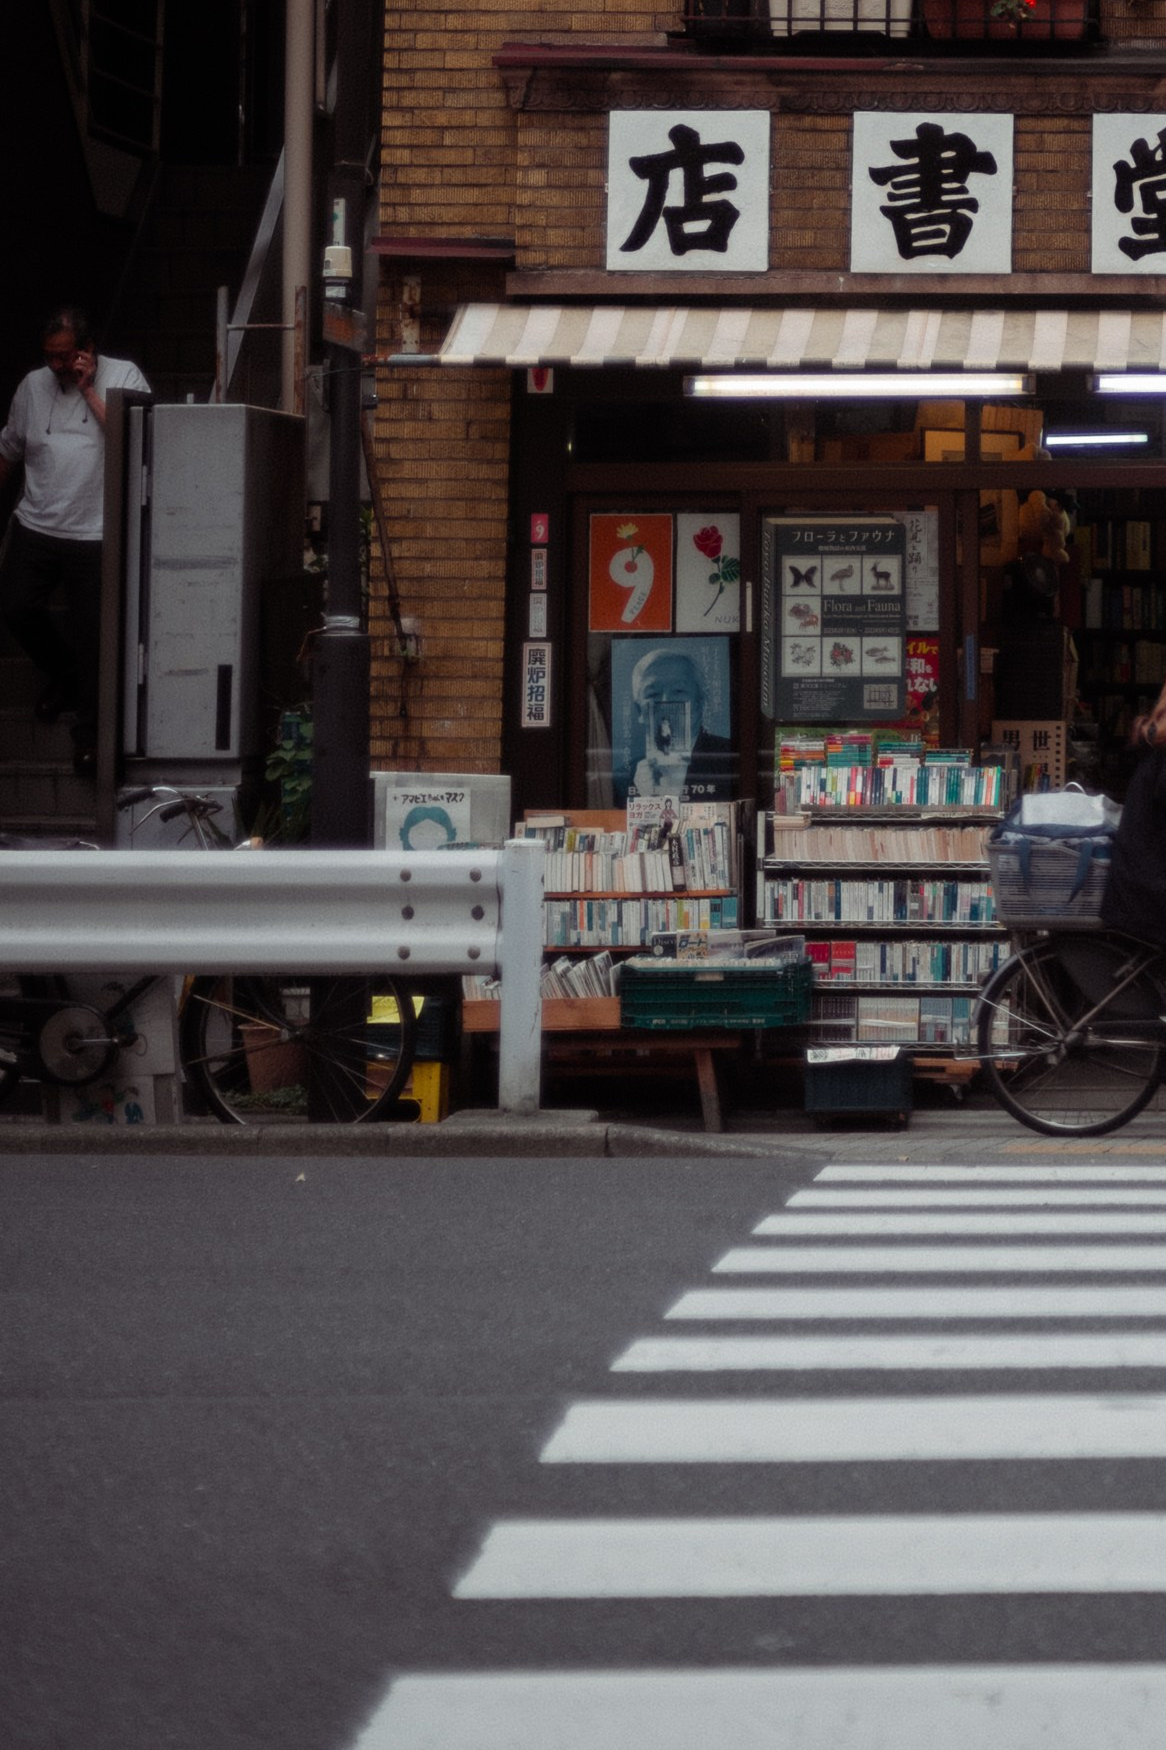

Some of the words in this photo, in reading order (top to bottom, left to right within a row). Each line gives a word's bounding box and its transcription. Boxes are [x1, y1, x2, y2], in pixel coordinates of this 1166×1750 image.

[791, 530, 895, 543] フローラとファウナ
[629, 591, 647, 615] PEACE
[823, 599, 852, 612] Flora
[867, 599, 901, 612] Fauna
[526, 647, 547, 722] 廃炉招福
[629, 803, 662, 811] リラックス
